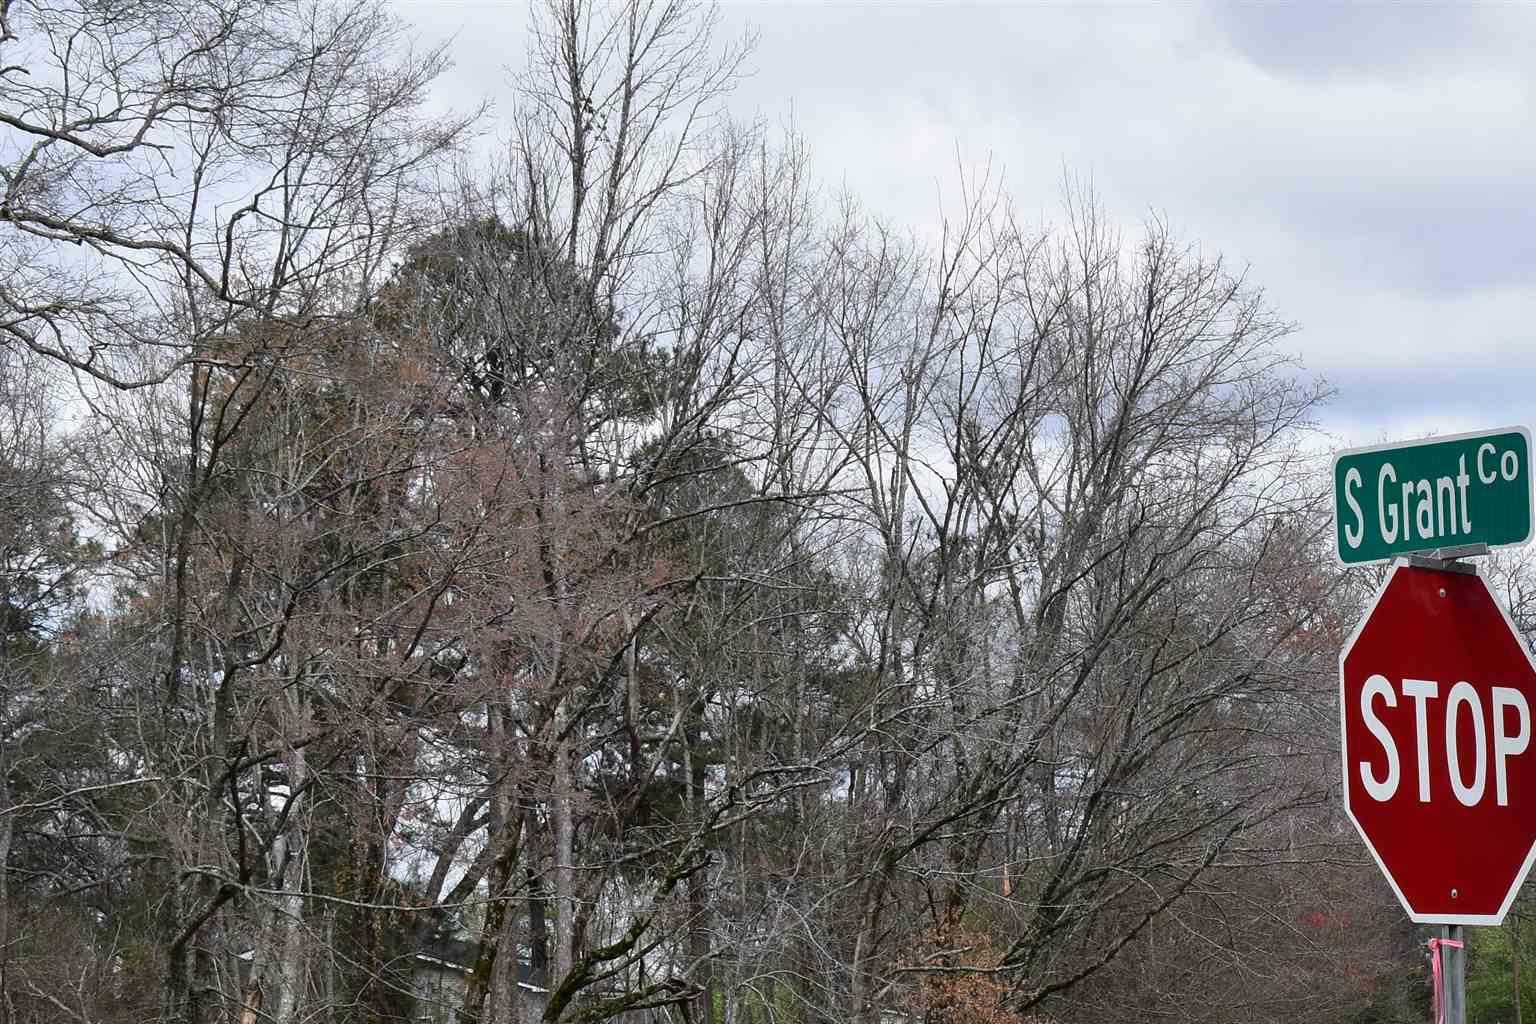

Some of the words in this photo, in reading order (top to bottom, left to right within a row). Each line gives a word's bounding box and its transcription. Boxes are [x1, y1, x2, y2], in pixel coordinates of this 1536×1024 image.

[1344, 467, 1365, 549] S
[1378, 453, 1472, 545] Grant
[1477, 442, 1519, 485] Co
[1359, 674, 1532, 807] STOP
